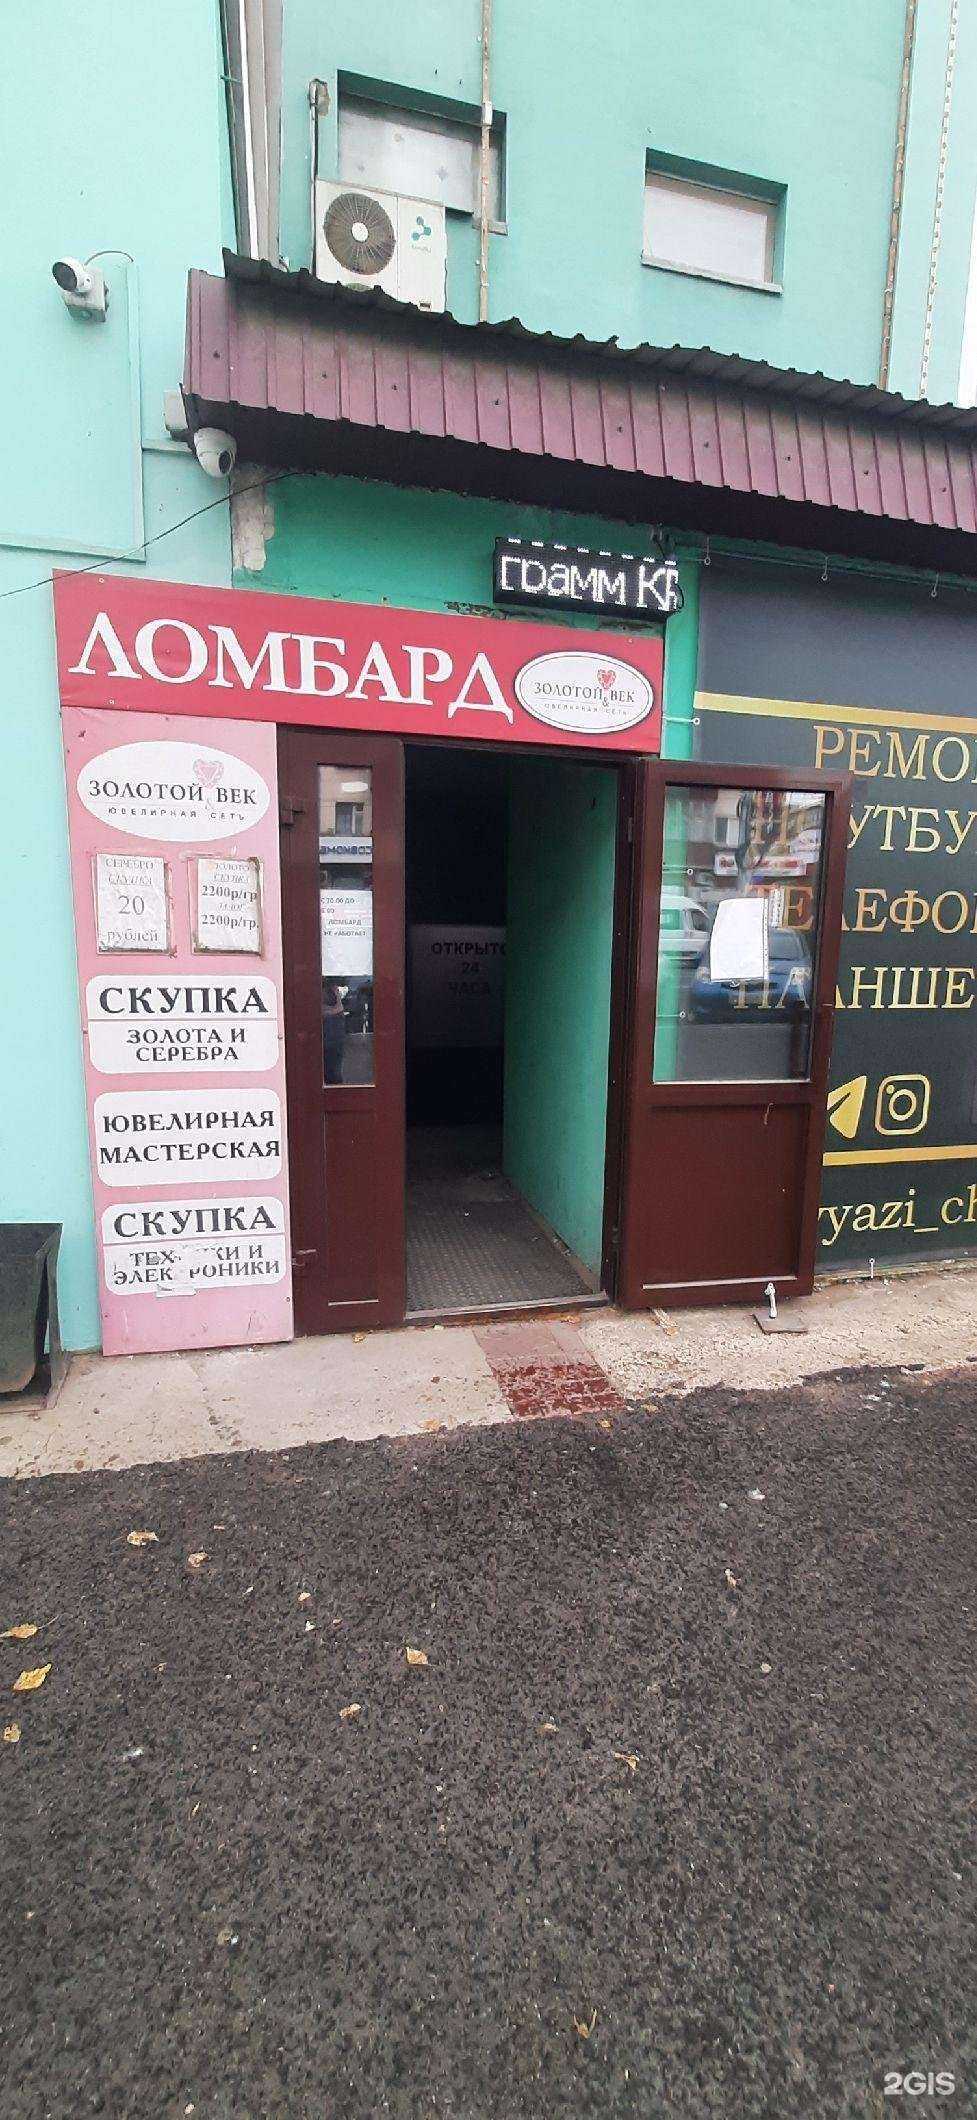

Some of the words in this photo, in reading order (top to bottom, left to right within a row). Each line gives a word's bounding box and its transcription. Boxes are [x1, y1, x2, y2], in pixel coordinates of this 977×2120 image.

[501, 555, 626, 606] грамм
[68, 612, 514, 724] ЛОМБАРД
[534, 682, 603, 700] ЗОЛОТОЙ
[610, 690, 635, 703] ВЕК
[813, 725, 977, 783] РЕМО
[89, 780, 203, 801] ЗОЛОТОЙ
[217, 787, 257, 805] ВЕК
[108, 806, 197, 818] ЮВЕЛИРНАЯ
[210, 812, 245, 821] СЕТЬ
[105, 858, 154, 870] СЕРЕБРО
[118, 895, 145, 915] 20
[106, 928, 159, 943] рублей
[99, 986, 269, 1014] СКУПКА
[126, 1028, 222, 1044] ЗОЛОТА
[231, 1028, 247, 1043] И
[135, 1046, 240, 1062] СЕРЕБРА
[103, 1110, 275, 1133] ЮВЕЛИРНАЯ
[100, 1140, 280, 1165] МАСТЕРСКАЯ
[113, 1205, 277, 1238] СКУПКА
[130, 1245, 240, 1267] ТЕХКИ
[249, 1244, 263, 1259] И
[113, 1259, 280, 1286] ЭЛЕКРОНИКИ
